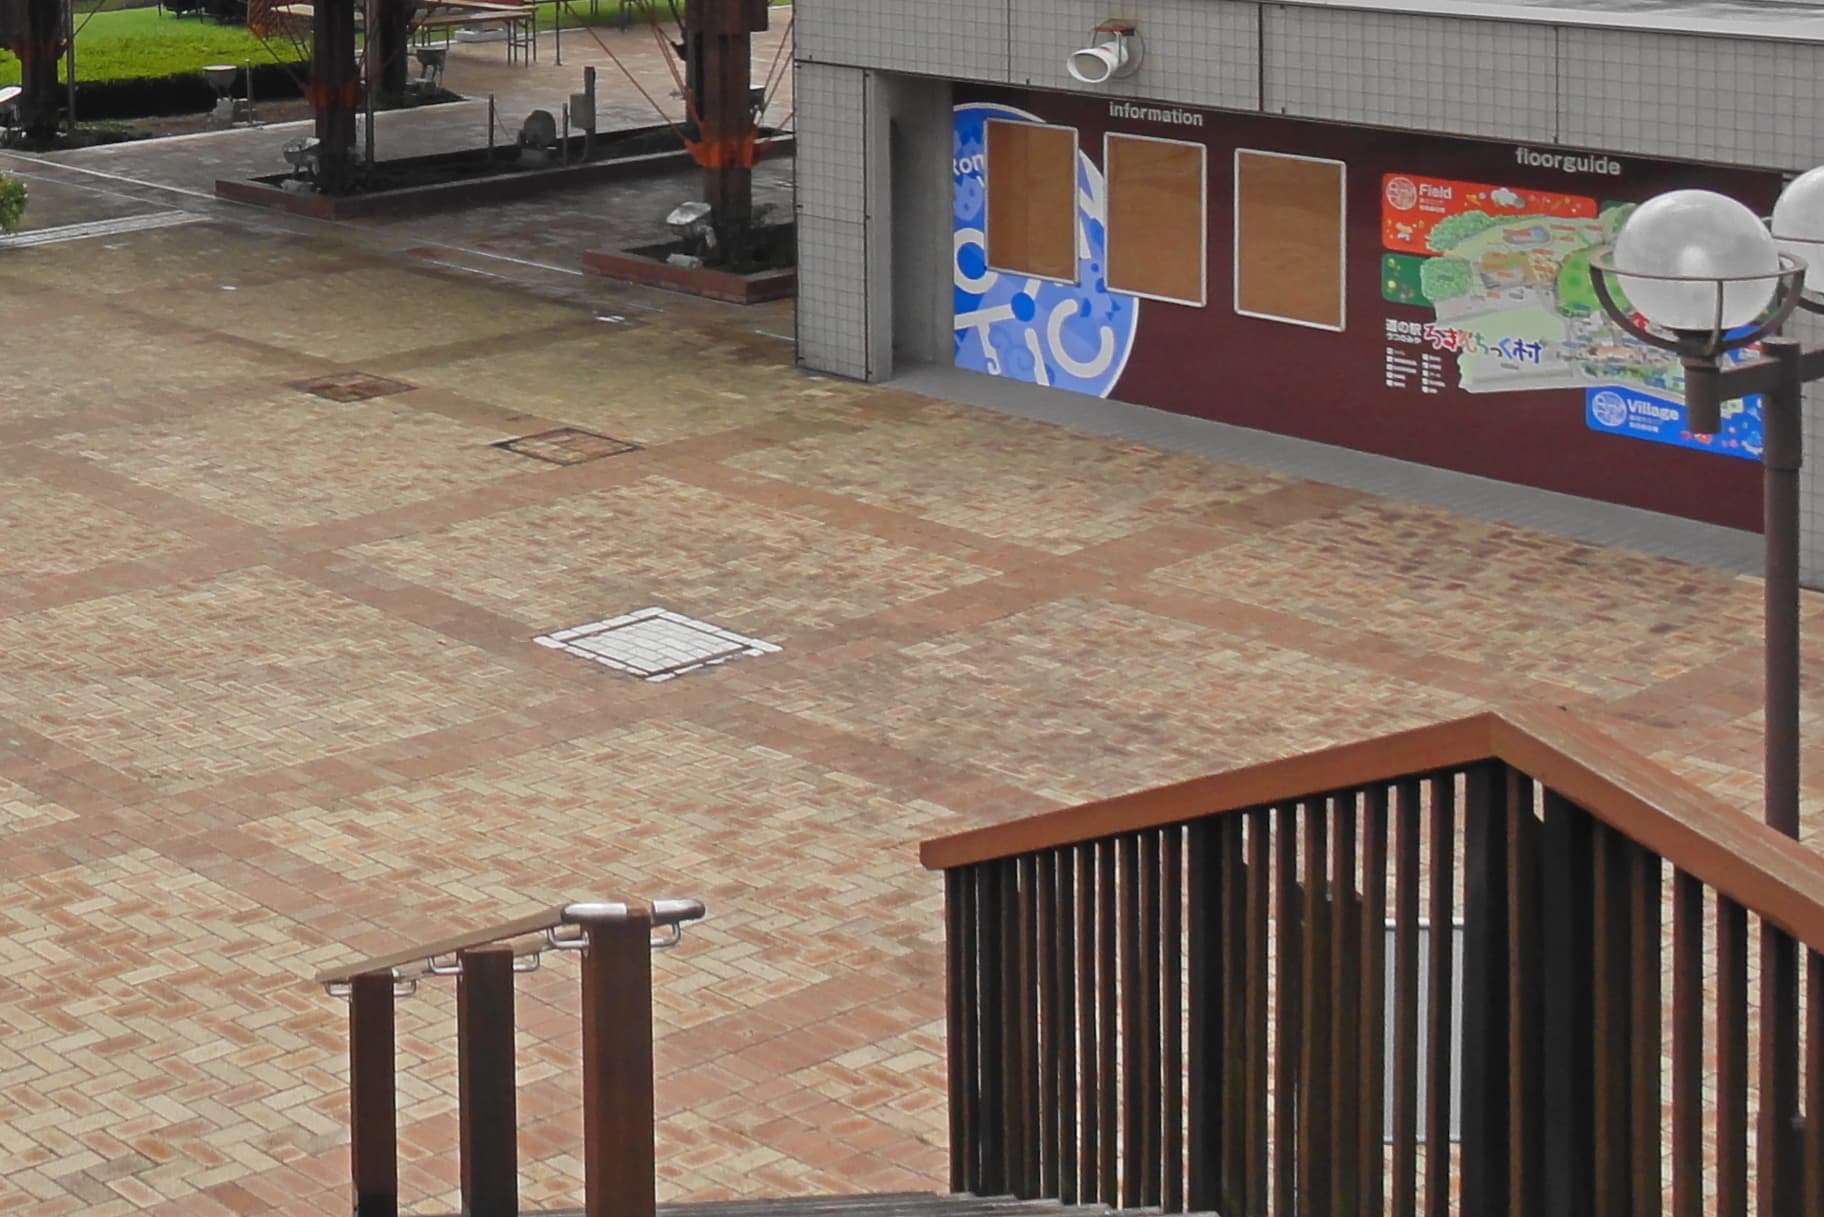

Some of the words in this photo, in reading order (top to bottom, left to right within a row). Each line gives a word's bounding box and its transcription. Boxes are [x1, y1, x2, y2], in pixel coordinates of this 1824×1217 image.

[1108, 101, 1204, 127] information
[1419, 184, 1453, 200] Field
[1423, 323, 1543, 364] ろまんちっく村
[1627, 398, 1680, 421] Village
